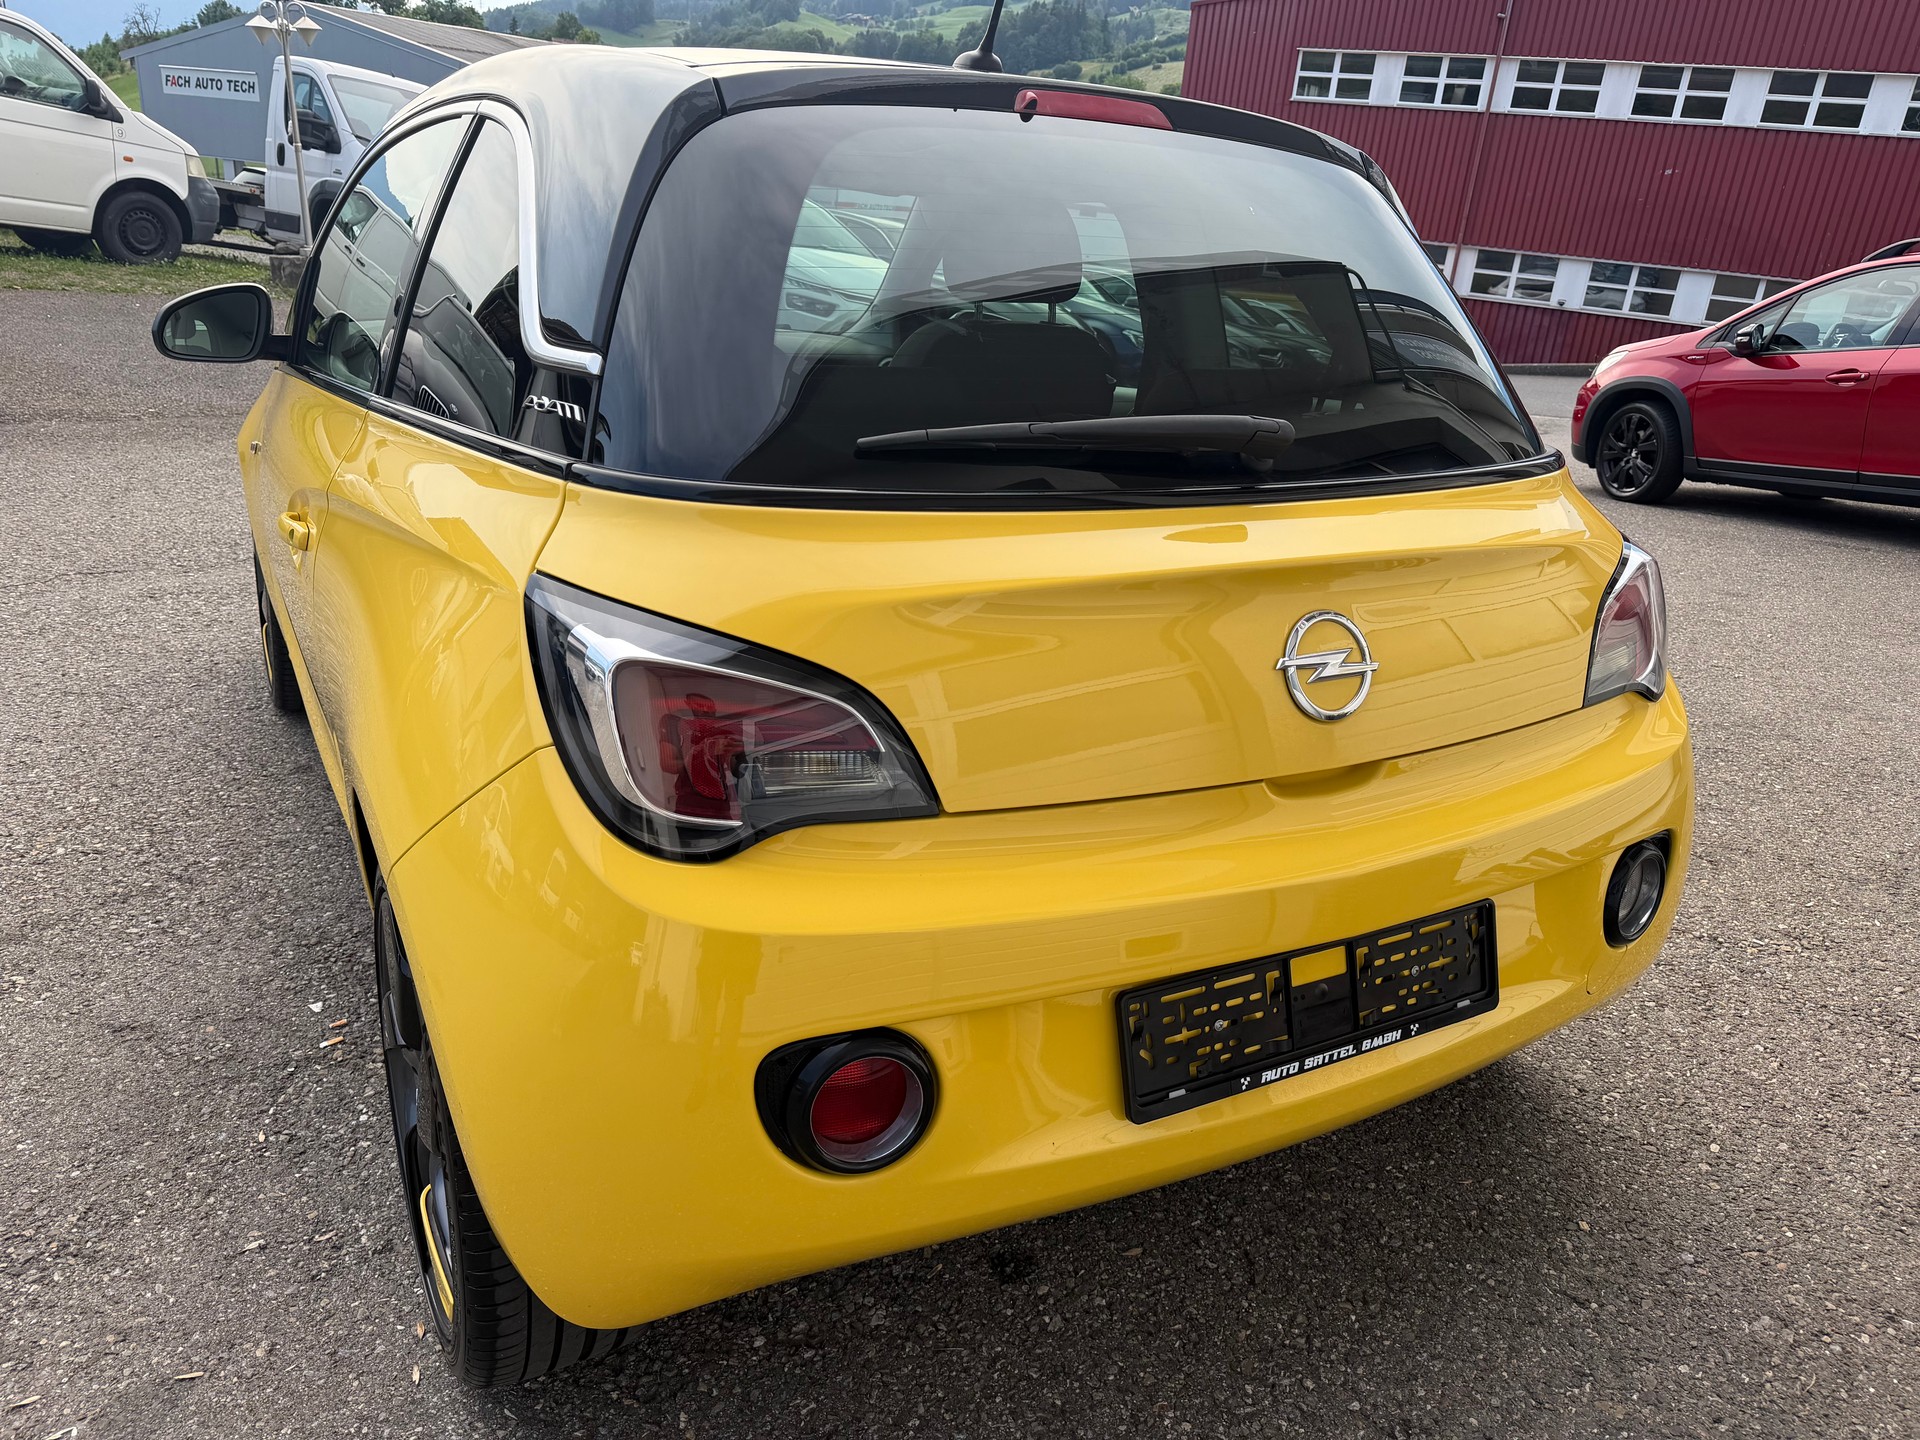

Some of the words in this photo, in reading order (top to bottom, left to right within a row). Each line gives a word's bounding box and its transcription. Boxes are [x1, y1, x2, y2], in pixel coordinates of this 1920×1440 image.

[165, 74, 191, 89] FACH
[195, 76, 223, 91] AUTO
[226, 79, 255, 94] TECH
[117, 128, 124, 138] 9
[1261, 1061, 1300, 1084] AUTO
[1303, 1044, 1357, 1070] SATTEL
[1361, 1029, 1402, 1051] GMBH
